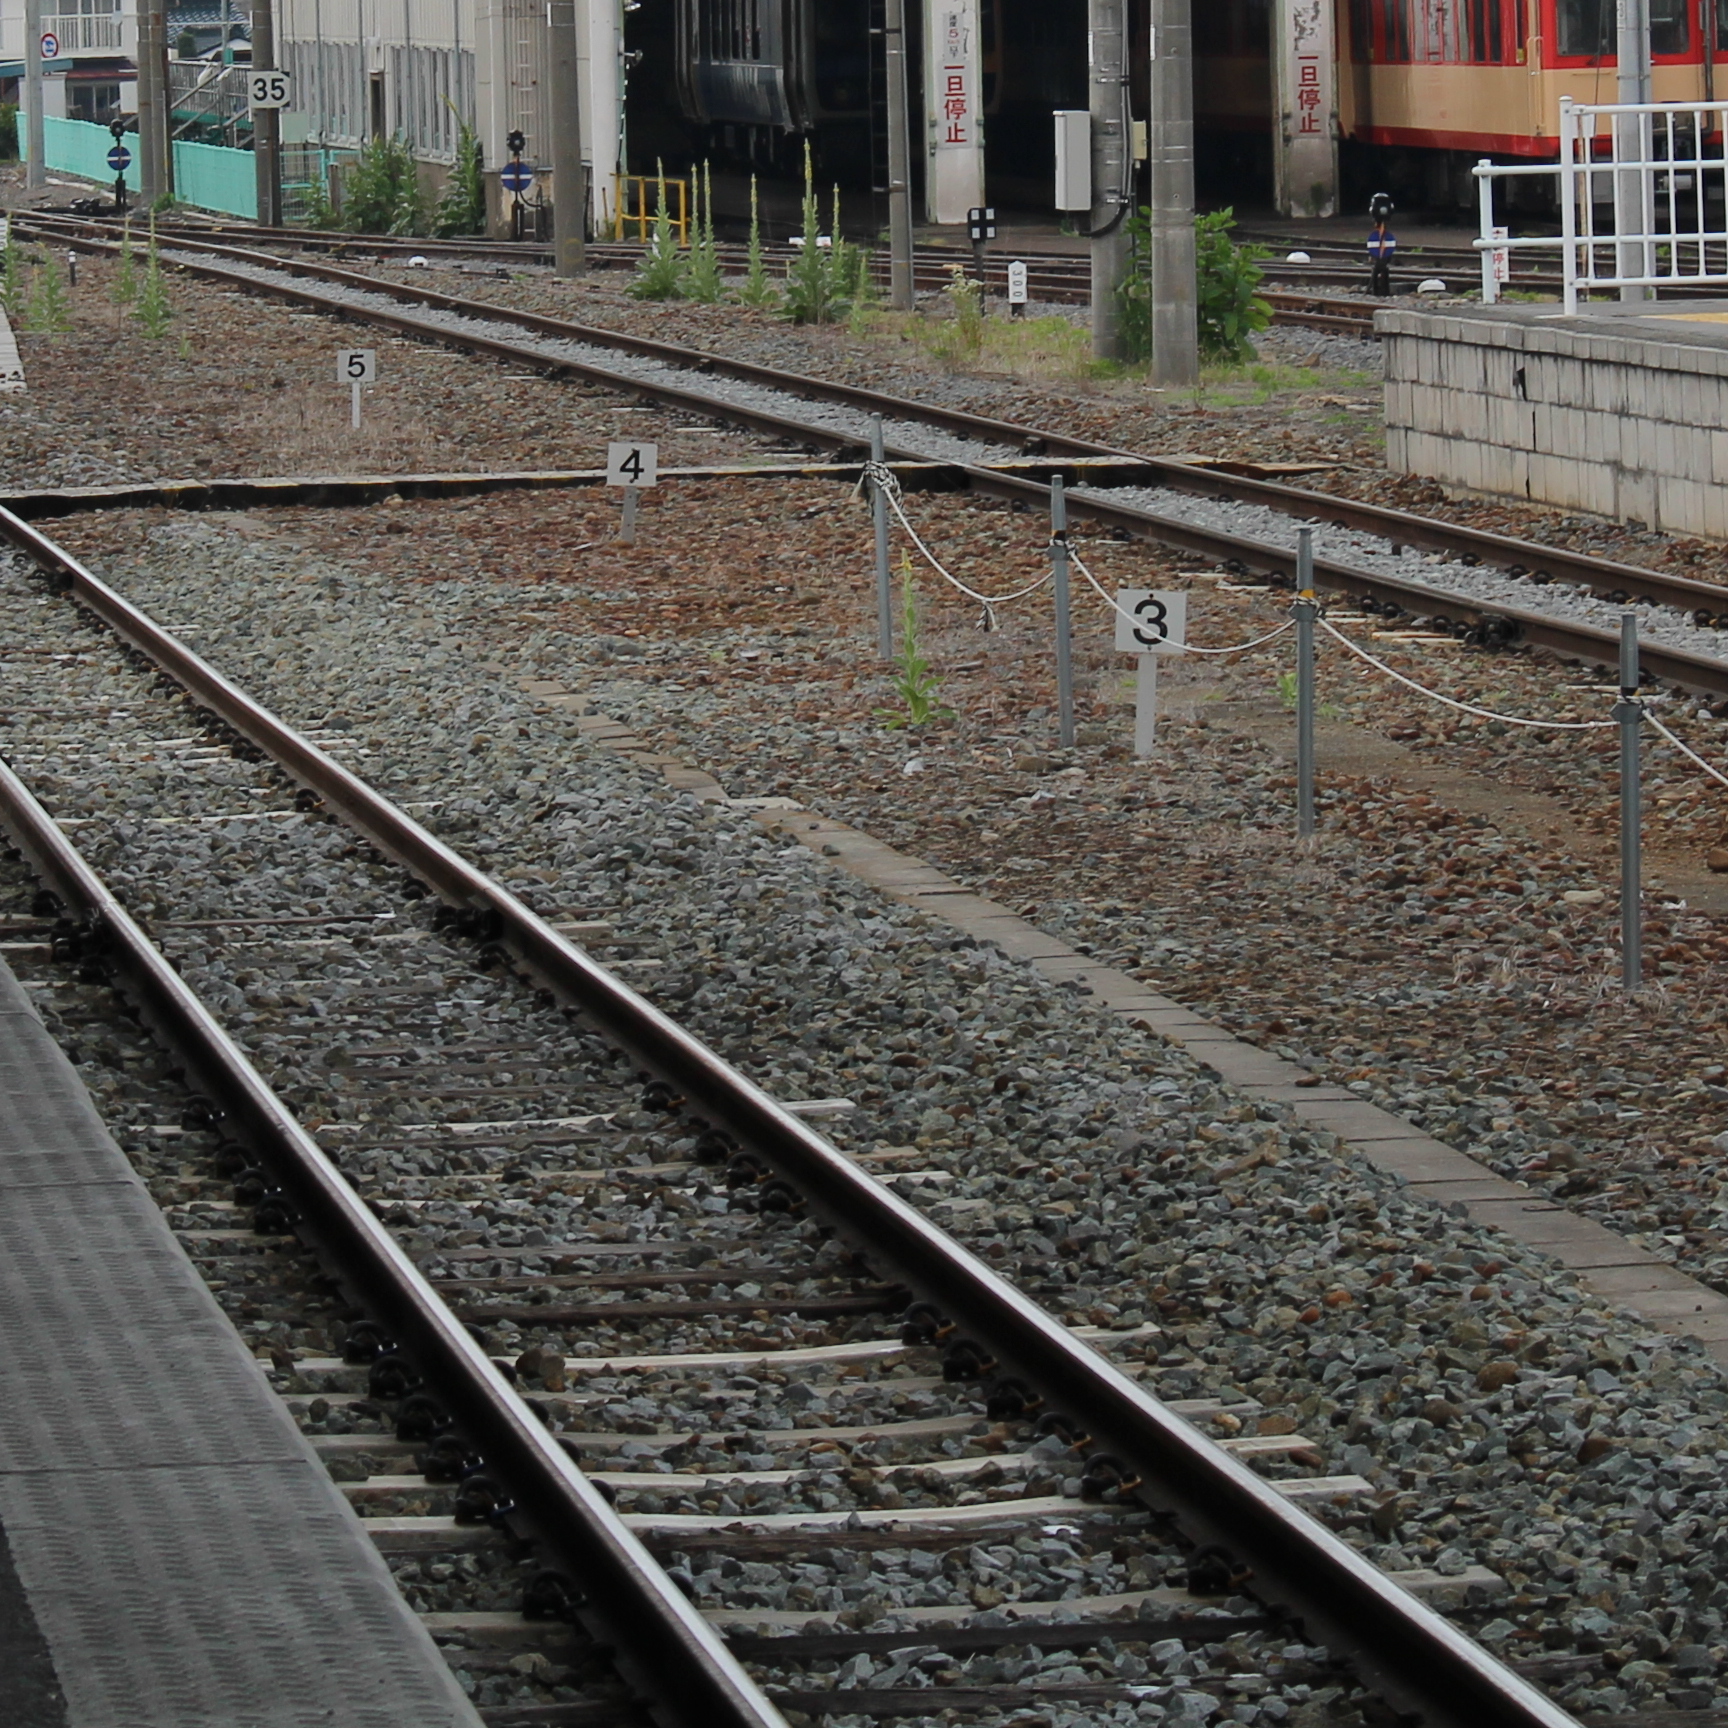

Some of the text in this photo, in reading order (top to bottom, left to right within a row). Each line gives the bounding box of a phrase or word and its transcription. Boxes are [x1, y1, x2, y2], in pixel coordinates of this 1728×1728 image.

[252, 78, 285, 102] 35
[943, 64, 968, 144] 一旦停止
[1297, 55, 1322, 134] 一旦停止
[1011, 270, 1023, 298] 300
[347, 354, 365, 378] 5
[619, 448, 645, 484] 4
[1131, 595, 1168, 647] 3
